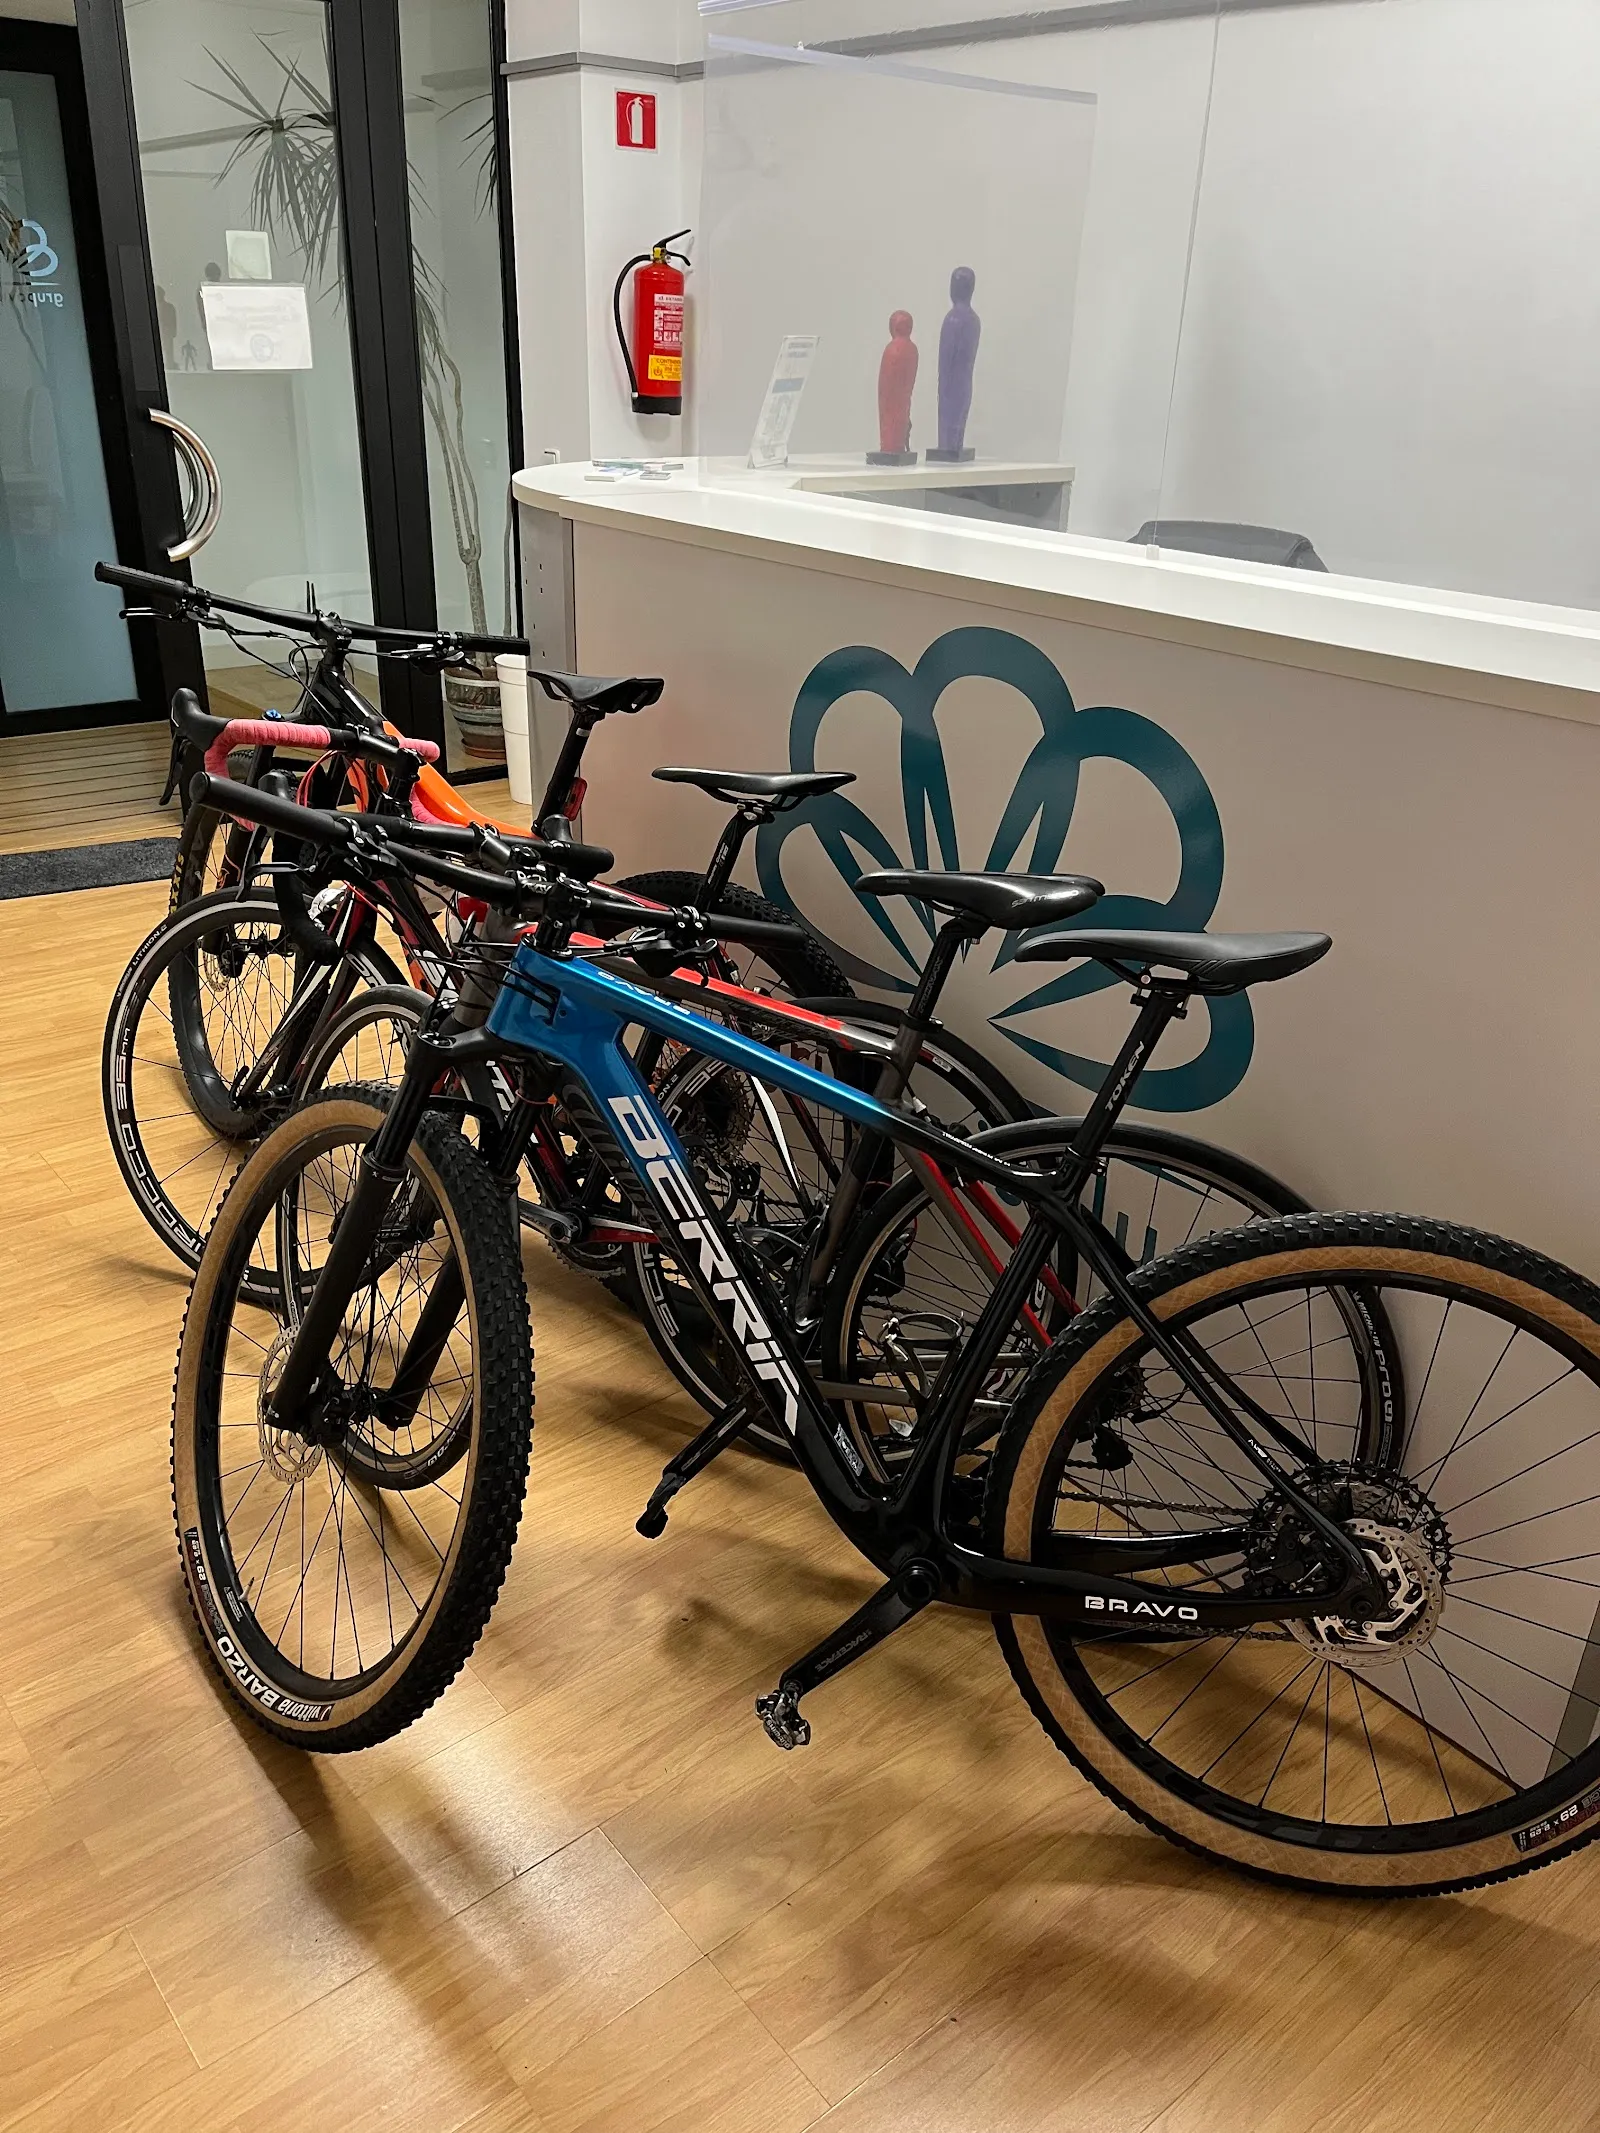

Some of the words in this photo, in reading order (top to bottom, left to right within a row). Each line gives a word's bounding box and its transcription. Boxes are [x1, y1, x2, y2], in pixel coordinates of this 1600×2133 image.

[1105, 1040, 1145, 1111] TOKEN
[1084, 1595, 1200, 1621] BRAVO
[216, 1634, 280, 1706] BARZO
[1559, 1804, 1579, 1822] 29
